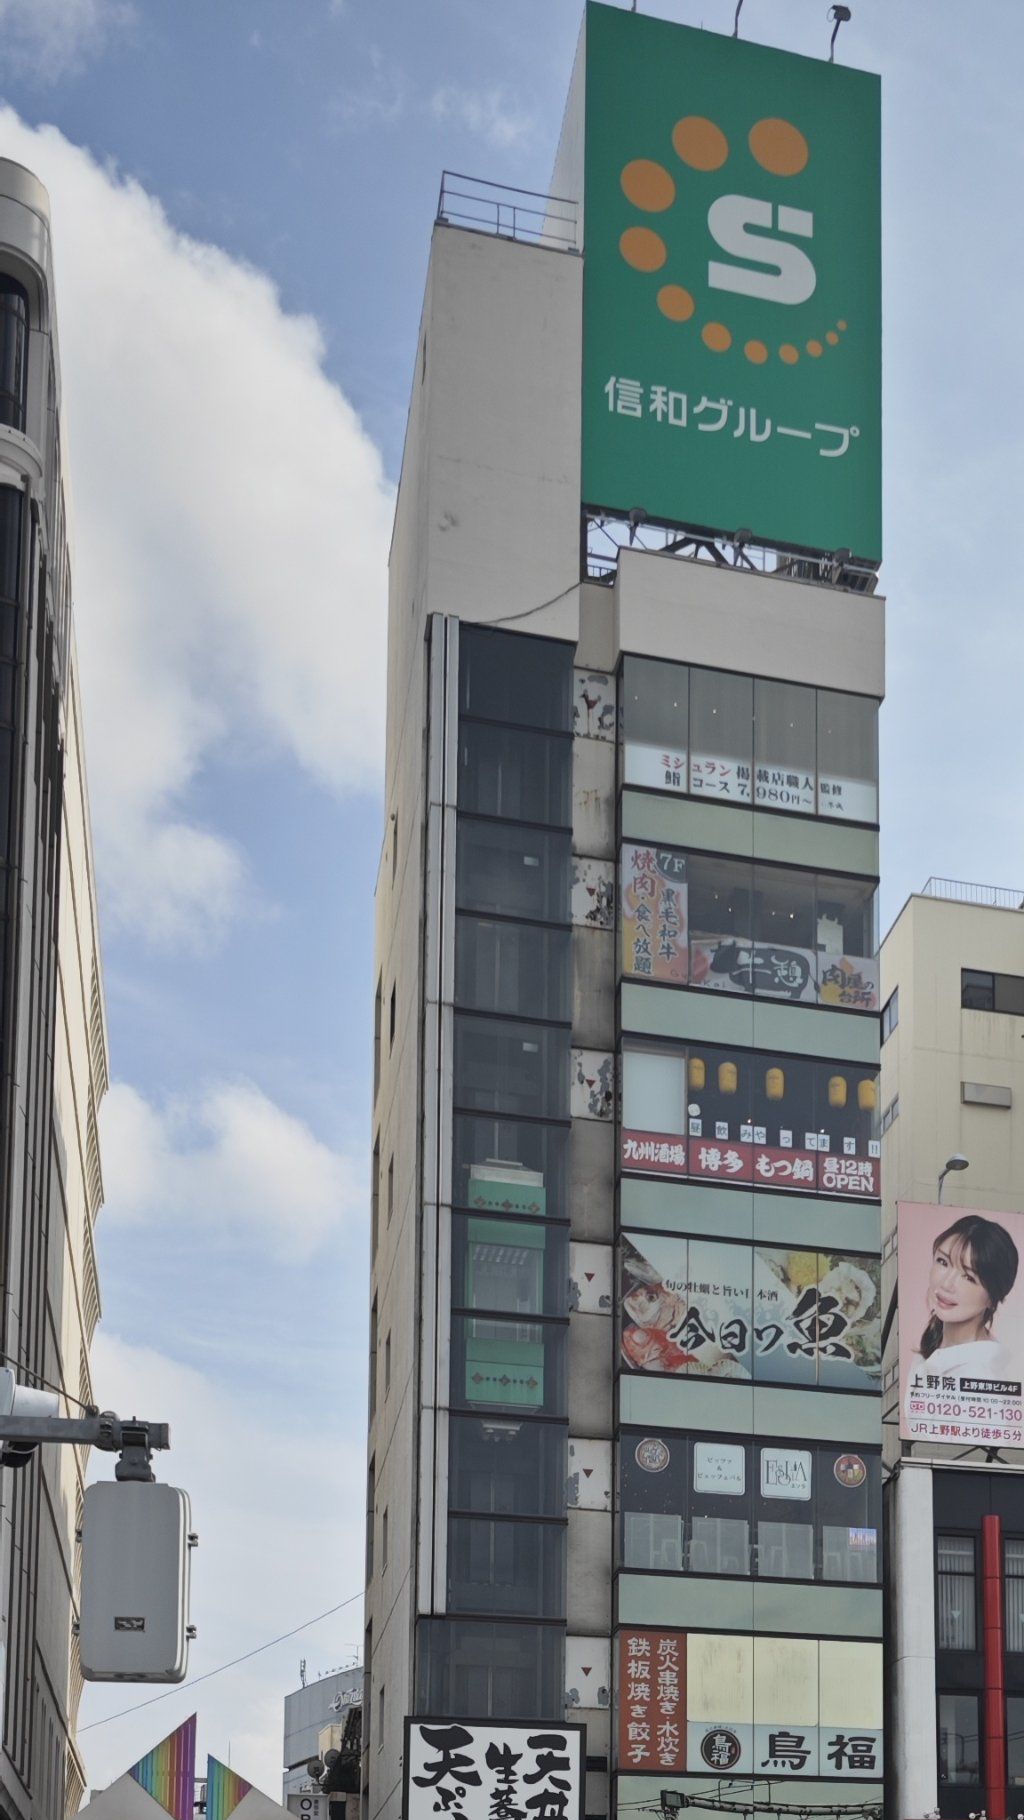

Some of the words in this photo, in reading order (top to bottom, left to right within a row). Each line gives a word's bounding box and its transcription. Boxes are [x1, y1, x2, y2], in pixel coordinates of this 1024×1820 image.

[604, 375, 860, 458] 信和グループ
[660, 853, 685, 873] 7F
[658, 888, 678, 961] 黒毛和牛
[623, 1139, 686, 1166] 九州酒場
[698, 1147, 744, 1173] 博多
[756, 1153, 814, 1181] もつ鍋
[823, 1157, 873, 1176] 昼12時
[823, 1173, 874, 1192] OPEN
[910, 1374, 956, 1391] 上野院
[927, 1402, 1023, 1421] 0120-521-130
[911, 1423, 1022, 1441] JR上野駅より徒歩5分
[627, 1636, 652, 1764] 鉄板焼き餃子
[656, 1638, 681, 1766] 炭火串焼き・水炊き
[761, 1731, 876, 1771] 鳥福
